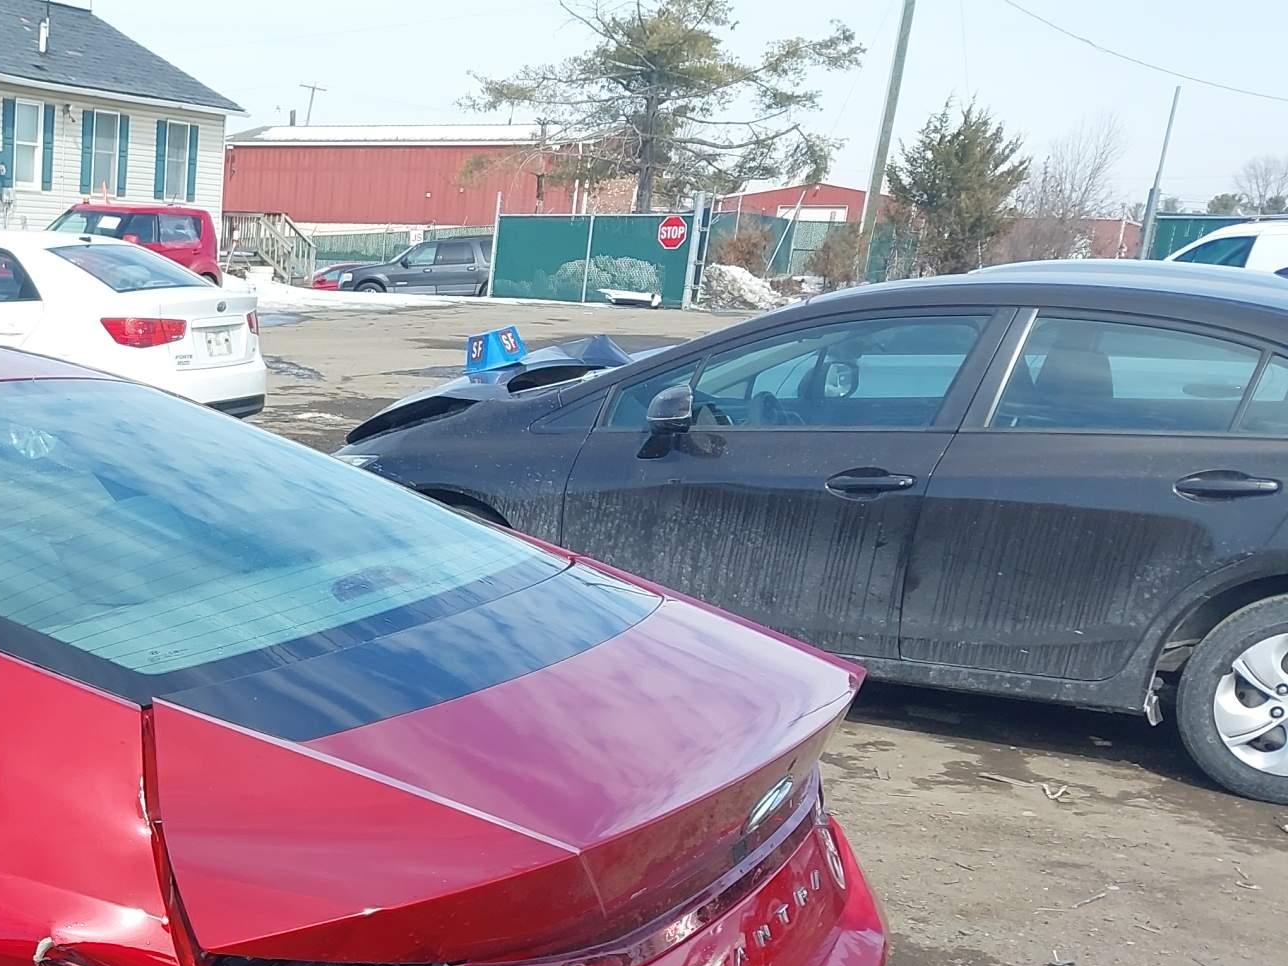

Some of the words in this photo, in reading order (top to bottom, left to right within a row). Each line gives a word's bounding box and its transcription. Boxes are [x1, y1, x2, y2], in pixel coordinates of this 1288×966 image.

[661, 226, 685, 239] STOP
[472, 340, 484, 359] SF
[501, 332, 518, 351] SF
